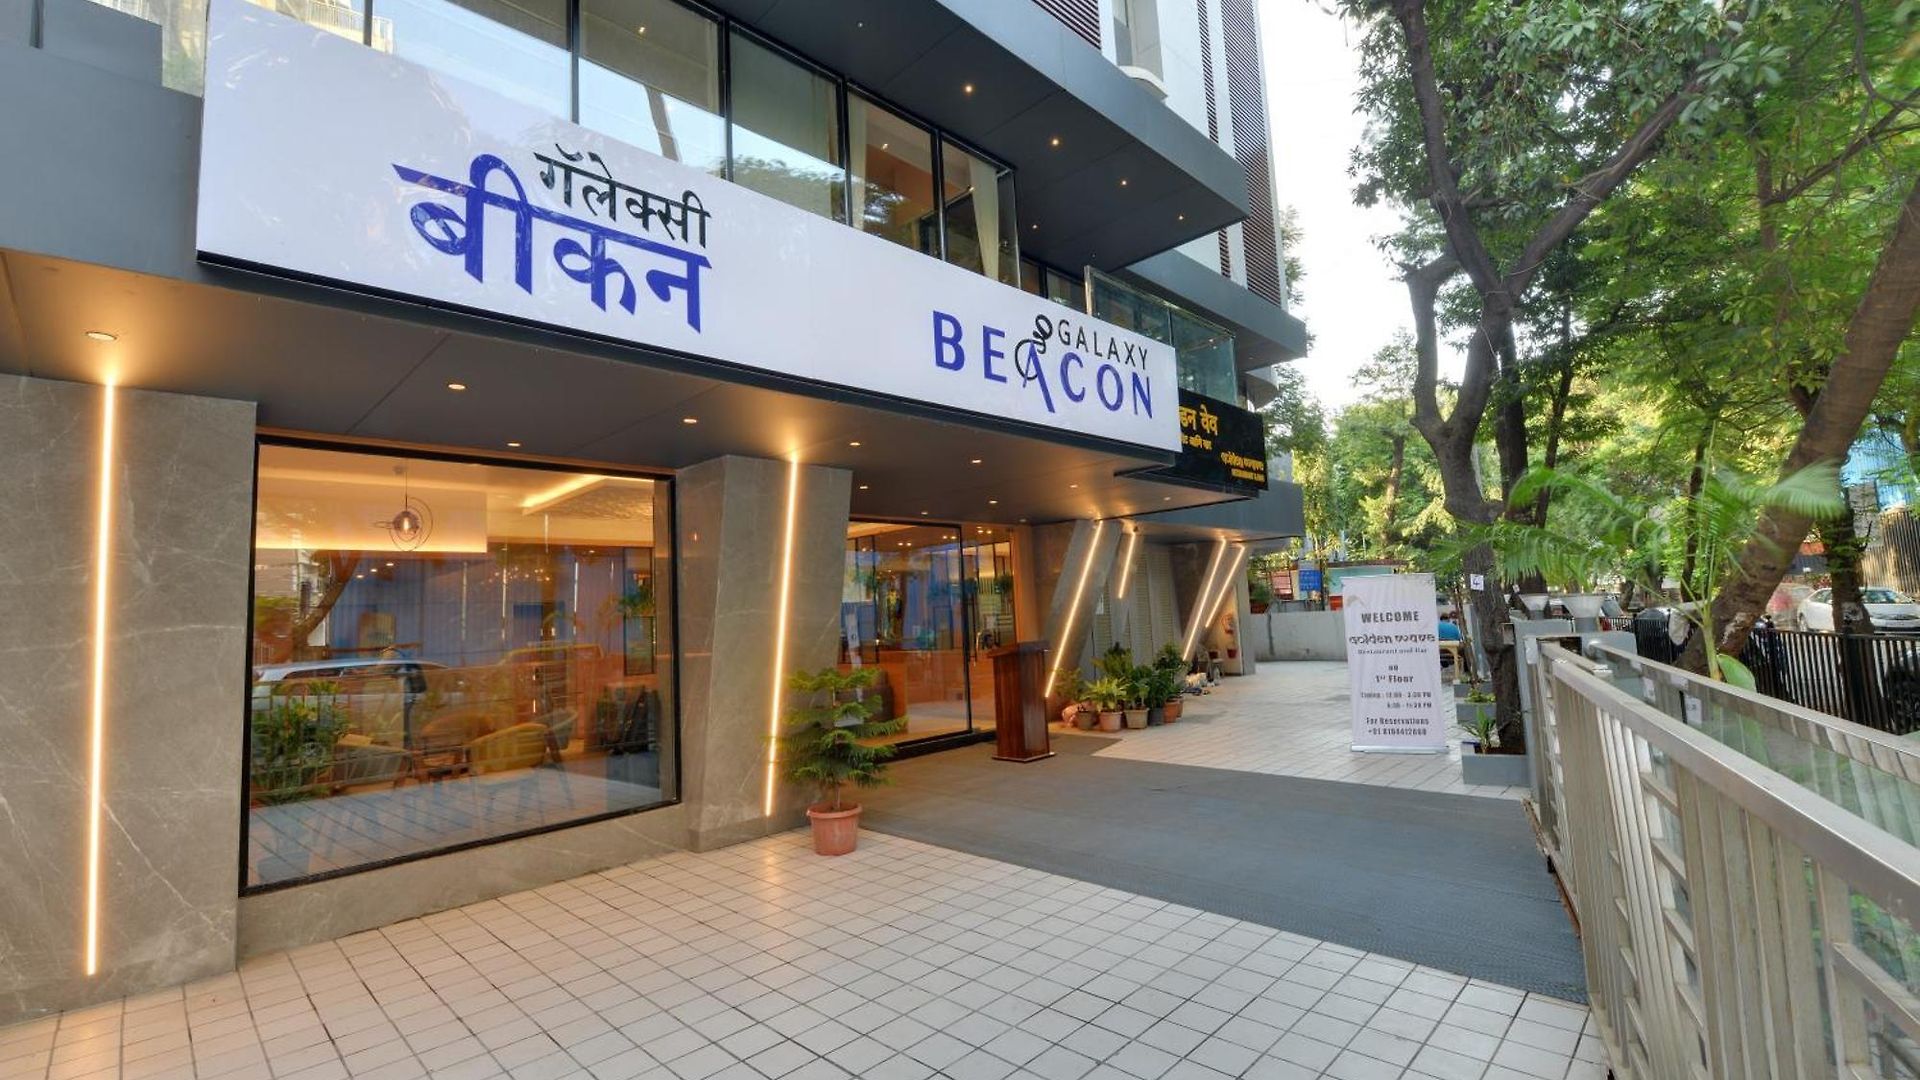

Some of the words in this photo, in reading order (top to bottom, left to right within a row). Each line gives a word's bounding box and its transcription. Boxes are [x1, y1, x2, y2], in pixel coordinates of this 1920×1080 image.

[533, 143, 712, 249] गॅलेक्सी
[392, 153, 712, 334] बीकन
[932, 310, 1153, 420] BEACON
[1058, 319, 1147, 371] GALAXY
[1361, 611, 1420, 623] WELCOME
[1388, 675, 1414, 683] Floor
[1366, 717, 1378, 725] For
[1379, 717, 1430, 725] Reservations
